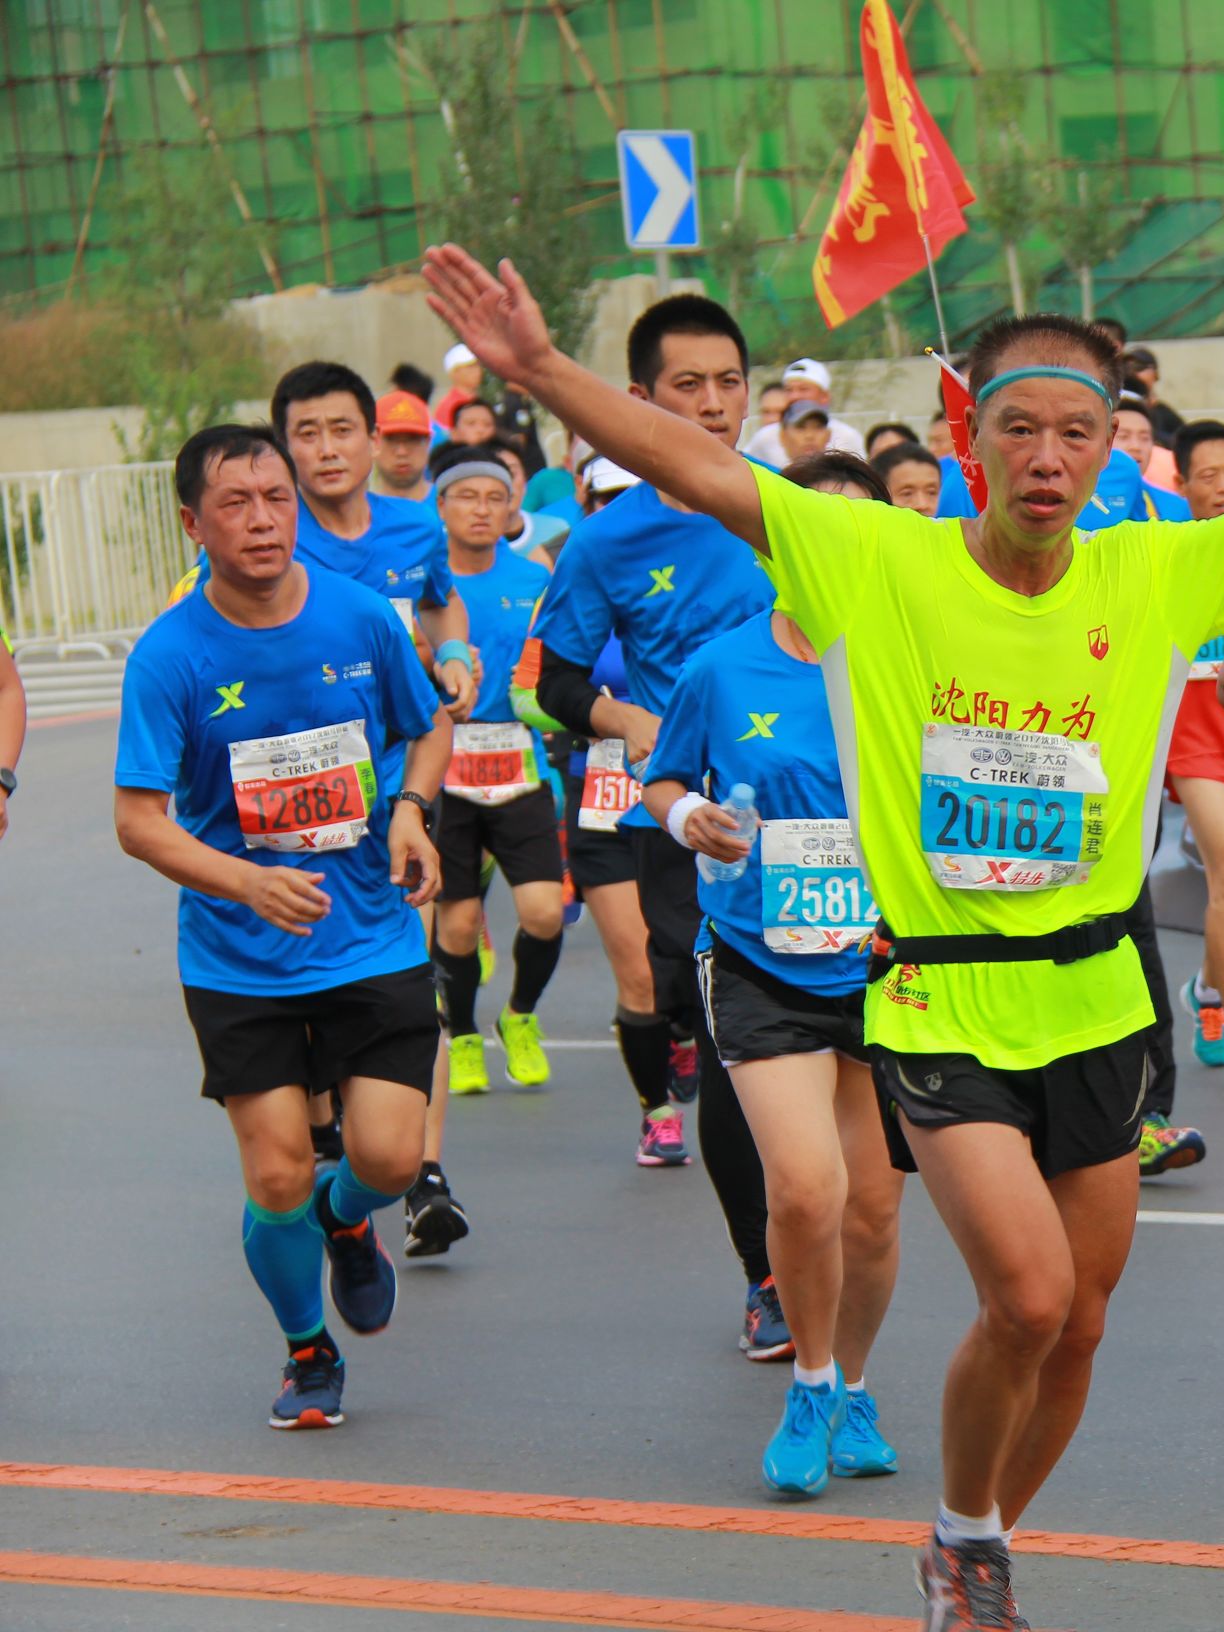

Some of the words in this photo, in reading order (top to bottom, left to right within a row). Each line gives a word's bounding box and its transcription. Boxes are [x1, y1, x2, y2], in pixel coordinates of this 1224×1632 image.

[931, 677, 1096, 741] 沈阳力为
[272, 761, 317, 777] C-TREK
[969, 767, 1030, 785] C-TREK
[1036, 774, 1066, 789] 蔚领
[252, 777, 353, 831] 12882
[936, 791, 1066, 854] 20182
[802, 854, 852, 865] C-TREK
[1009, 871, 1046, 885] 特步
